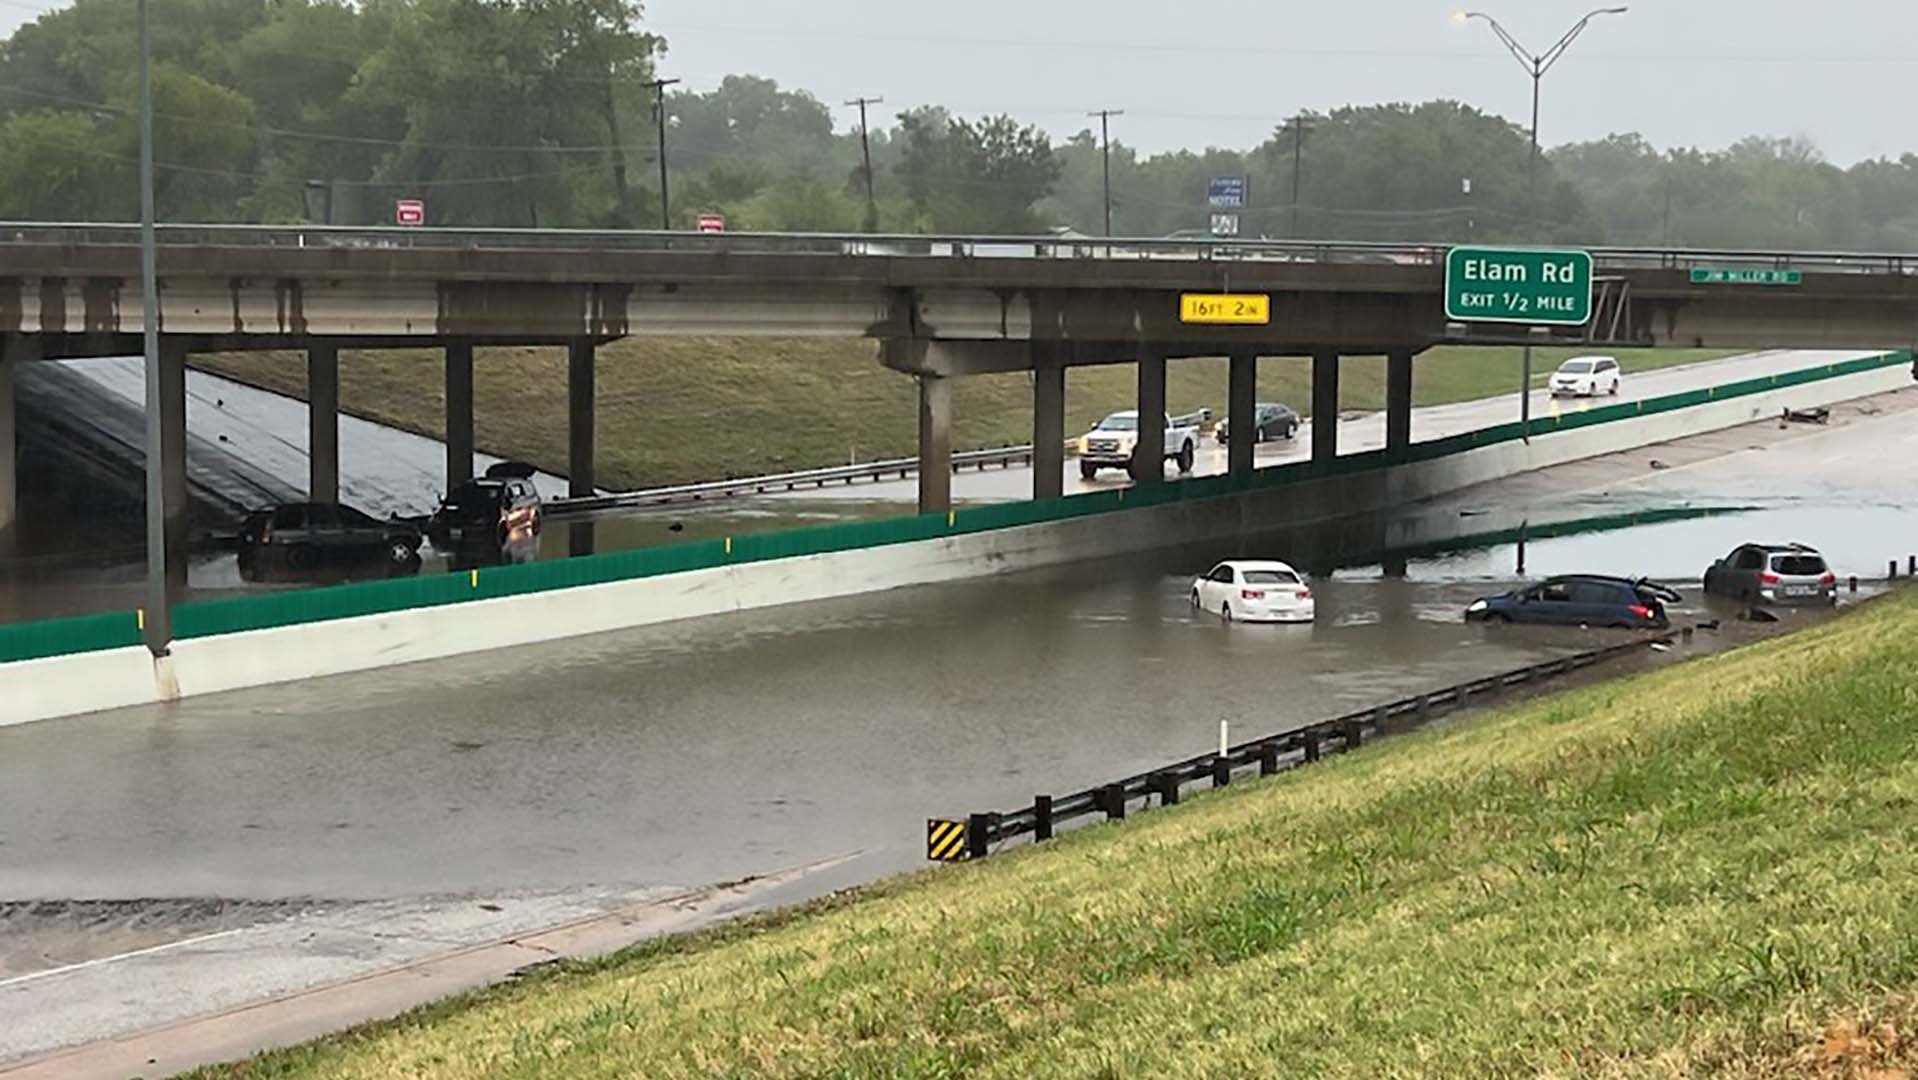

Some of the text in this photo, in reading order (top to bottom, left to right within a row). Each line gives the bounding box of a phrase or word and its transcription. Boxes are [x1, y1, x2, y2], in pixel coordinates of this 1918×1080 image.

[1464, 259, 1575, 284] Elam Rd
[1460, 292, 1495, 307] EXIT
[1536, 296, 1575, 311] MILE
